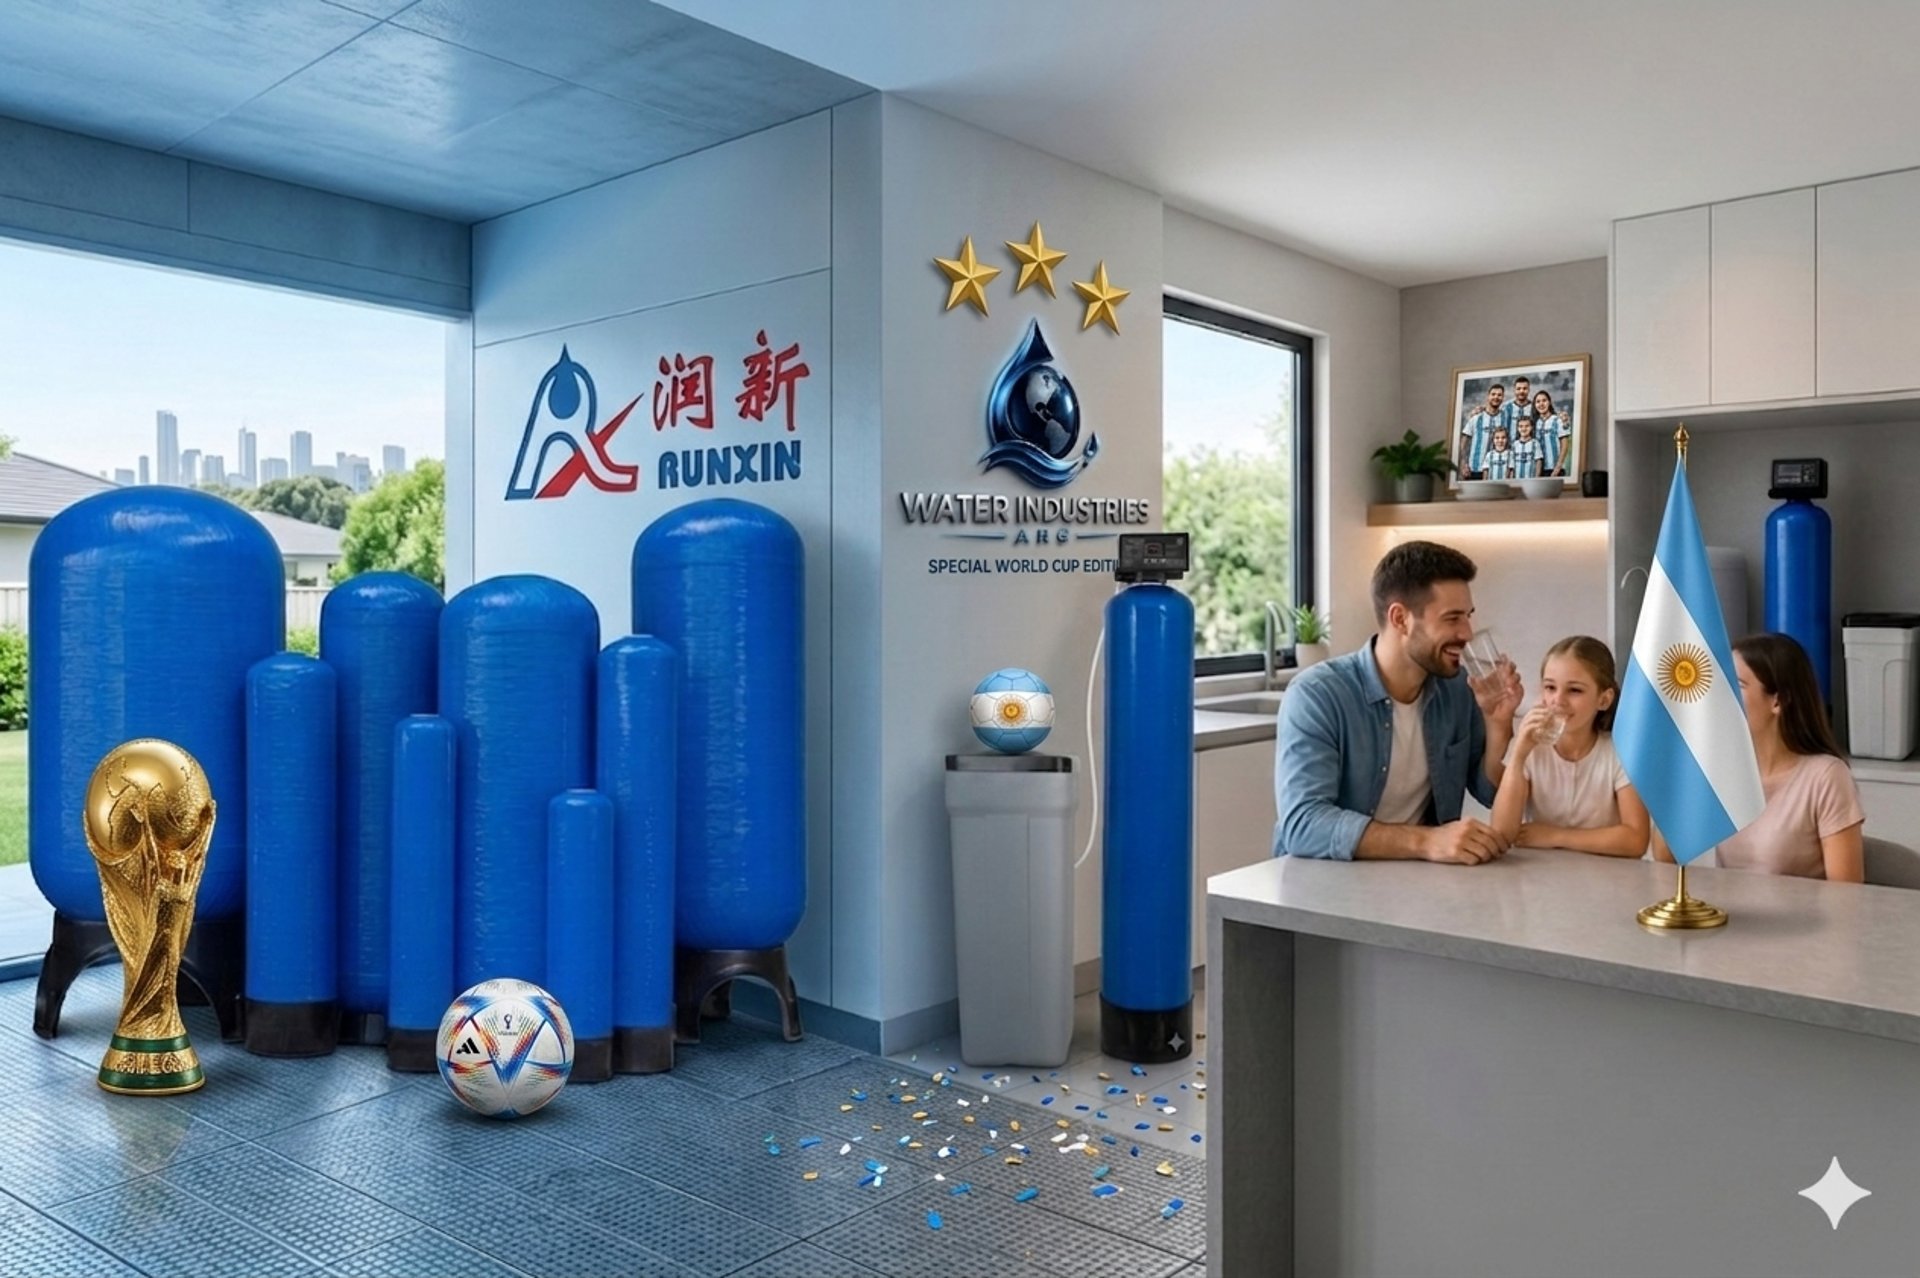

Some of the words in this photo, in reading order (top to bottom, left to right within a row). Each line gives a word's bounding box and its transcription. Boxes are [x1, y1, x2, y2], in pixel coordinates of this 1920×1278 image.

[653, 329, 811, 432] 润新
[658, 440, 801, 489] RUNXIN
[900, 492, 1009, 524] WATER
[1015, 496, 1150, 525] INDUSTRIES
[928, 559, 992, 574] SPECIAL
[995, 559, 1049, 574] WORLD
[1052, 559, 1080, 573] CUP
